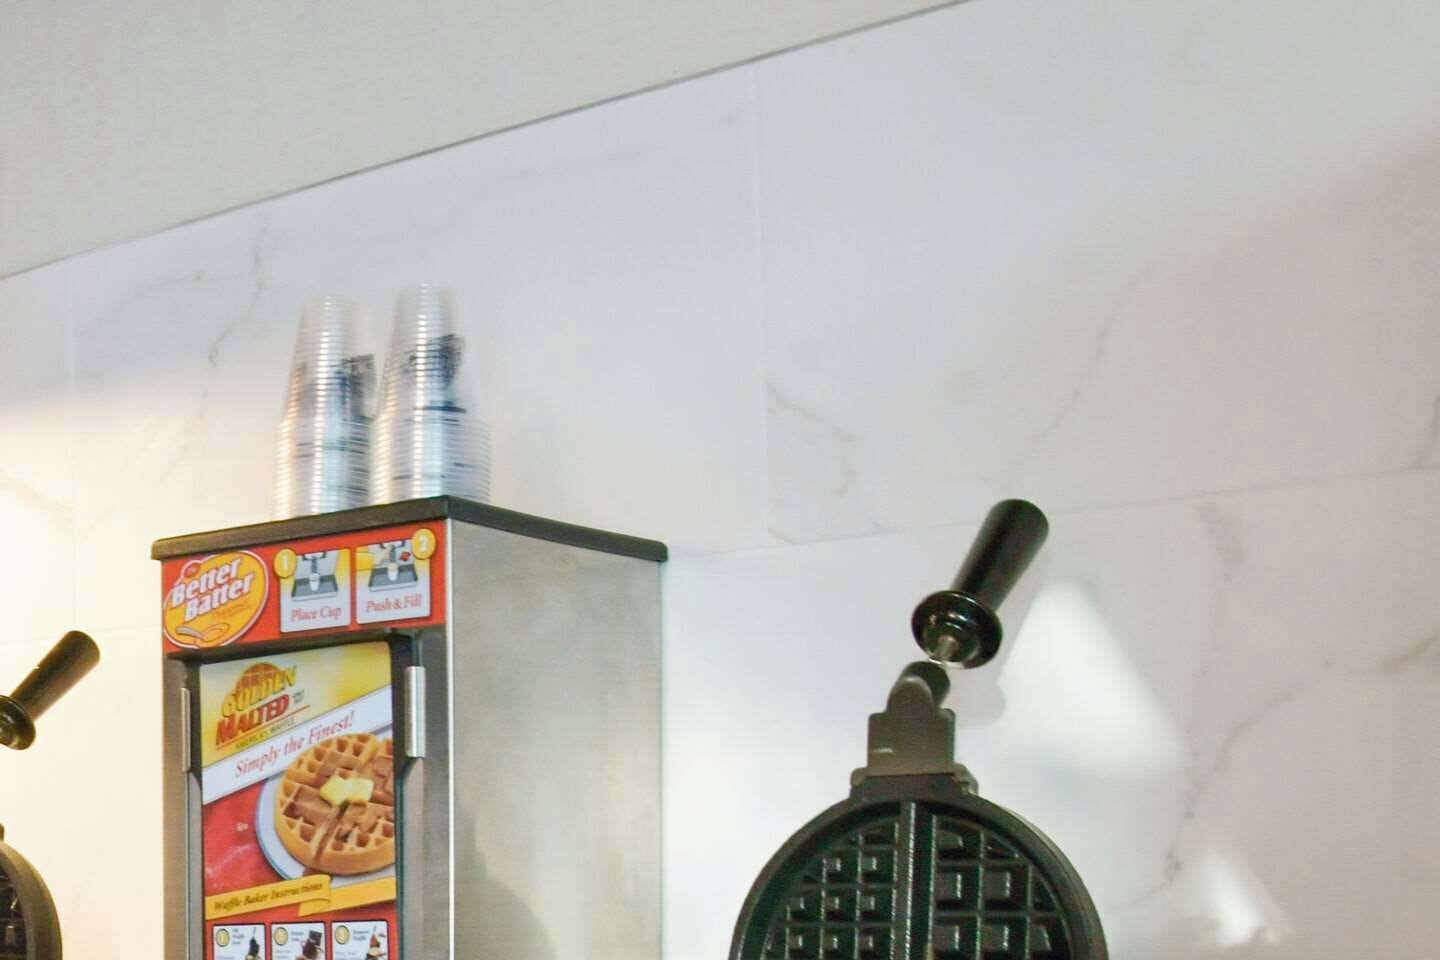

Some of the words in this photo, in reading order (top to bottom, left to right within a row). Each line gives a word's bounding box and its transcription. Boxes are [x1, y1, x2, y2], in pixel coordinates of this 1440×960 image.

[282, 557, 289, 570] 1
[420, 536, 428, 550] 2
[171, 558, 241, 609] Better
[184, 573, 255, 622] Batter
[367, 597, 392, 613] Push
[393, 599, 401, 609] &
[404, 593, 423, 608] Fill
[291, 607, 319, 622] Place
[320, 605, 342, 620] Cup
[221, 666, 297, 718] GOLDEN
[216, 694, 289, 746] MALTED
[235, 745, 278, 777] Simply
[284, 736, 305, 756] the
[308, 710, 355, 745] Finest!
